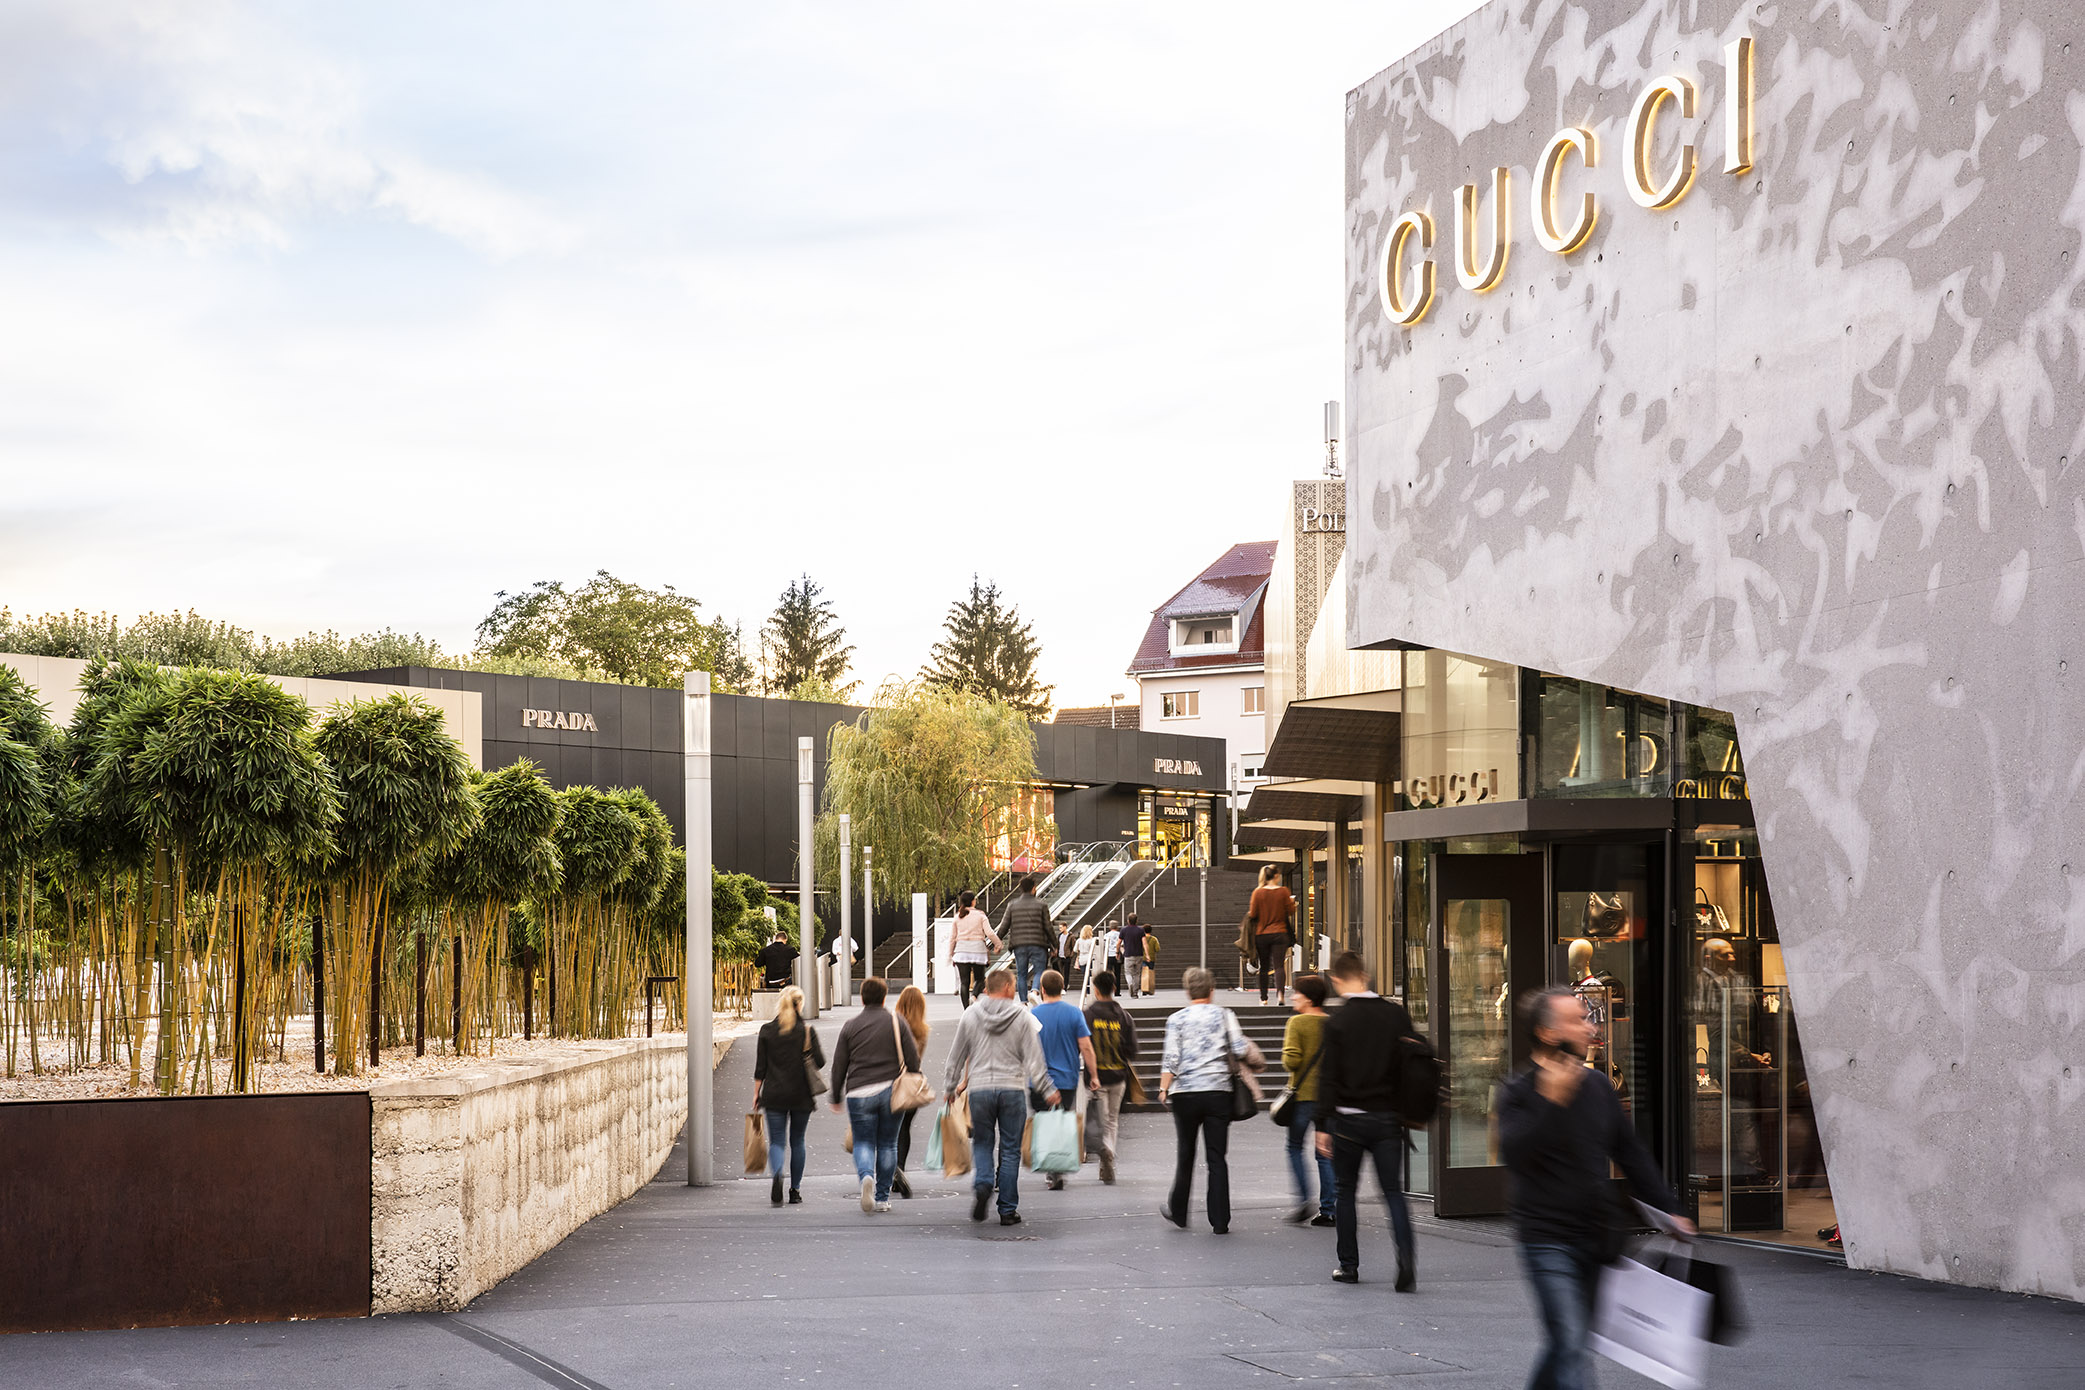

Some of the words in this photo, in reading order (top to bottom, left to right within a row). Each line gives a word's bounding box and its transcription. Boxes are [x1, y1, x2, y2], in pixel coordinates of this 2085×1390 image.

[1379, 36, 1754, 325] GUCCI
[522, 708, 599, 732] PRADA
[1154, 758, 1203, 776] PRADA
[1409, 768, 1498, 807] GUCCI
[1164, 806, 1189, 816] PRADA
